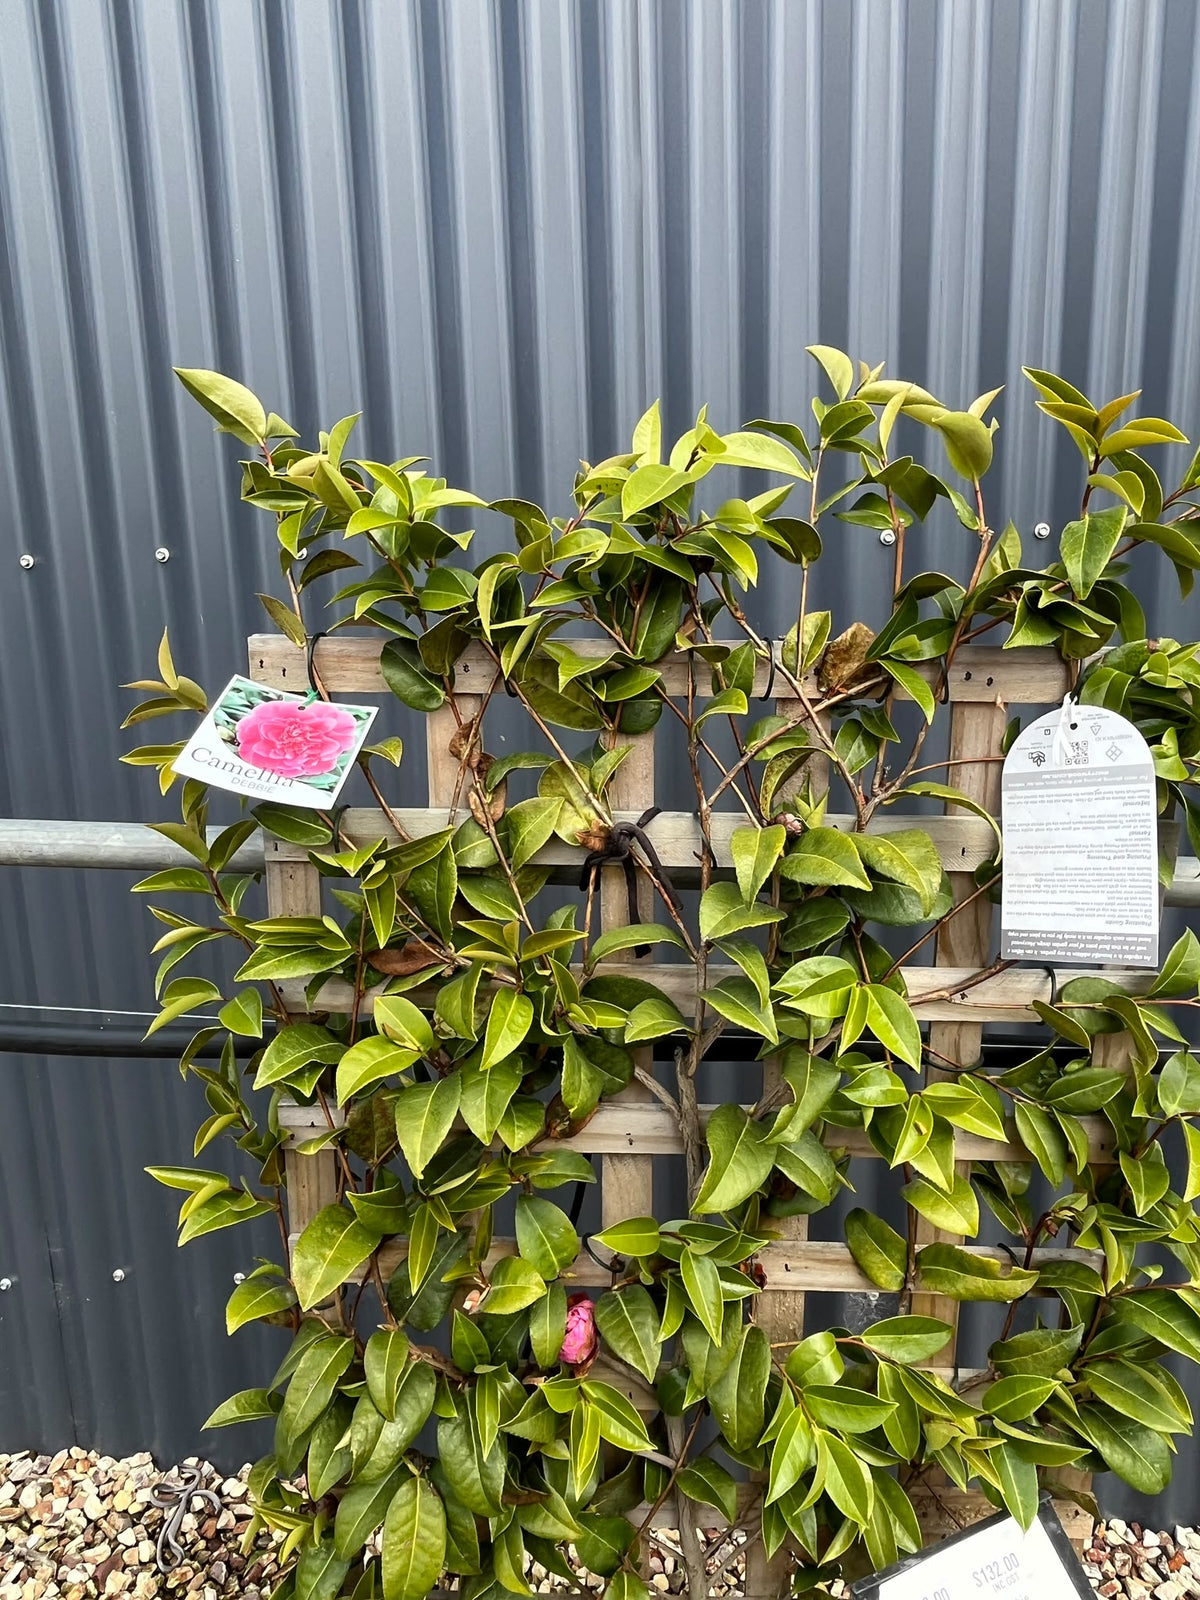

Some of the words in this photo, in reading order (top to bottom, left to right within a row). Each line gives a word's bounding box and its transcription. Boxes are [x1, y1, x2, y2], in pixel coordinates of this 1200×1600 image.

[191, 747, 294, 788] Camellia
[231, 776, 275, 794] DEBBIE
[972, 1552, 1019, 1587] $132.00
[1006, 1571, 1020, 1586] GST
